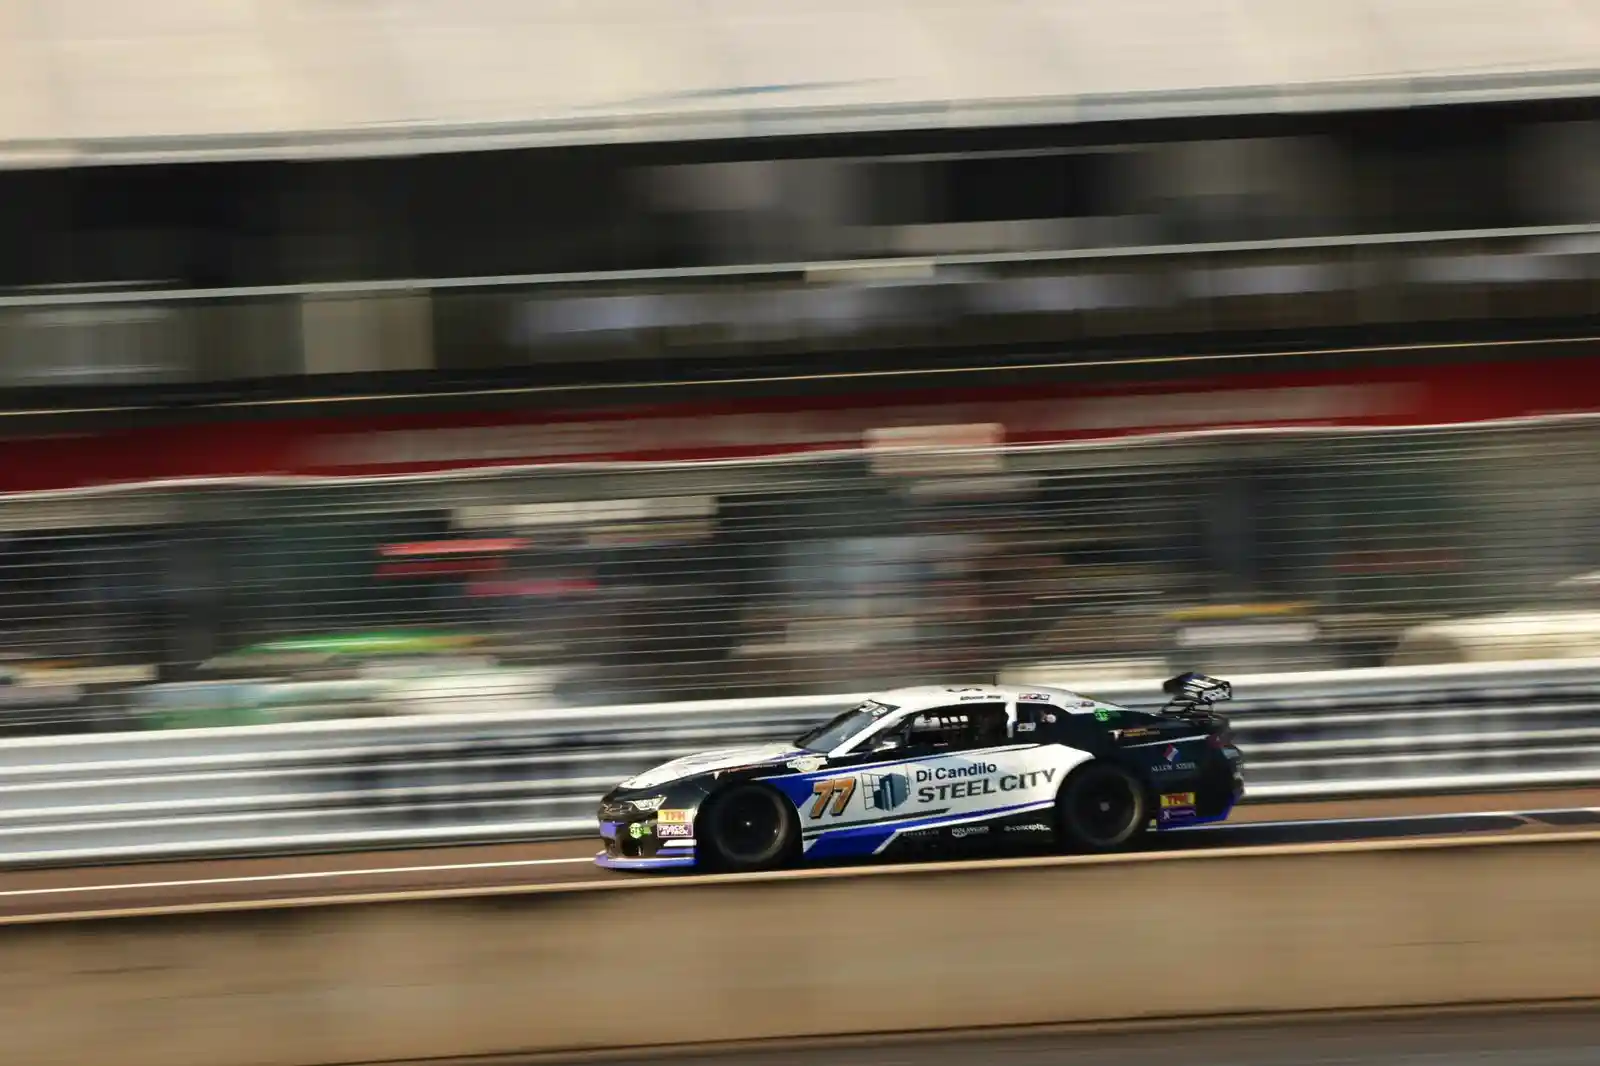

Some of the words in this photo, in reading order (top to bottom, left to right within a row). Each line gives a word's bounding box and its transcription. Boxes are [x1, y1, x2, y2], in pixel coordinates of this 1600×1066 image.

[916, 769, 932, 782] Di
[935, 763, 997, 780] Candilo
[917, 778, 997, 803] STEEL
[1000, 768, 1056, 792] CITY
[809, 777, 857, 820] 77
